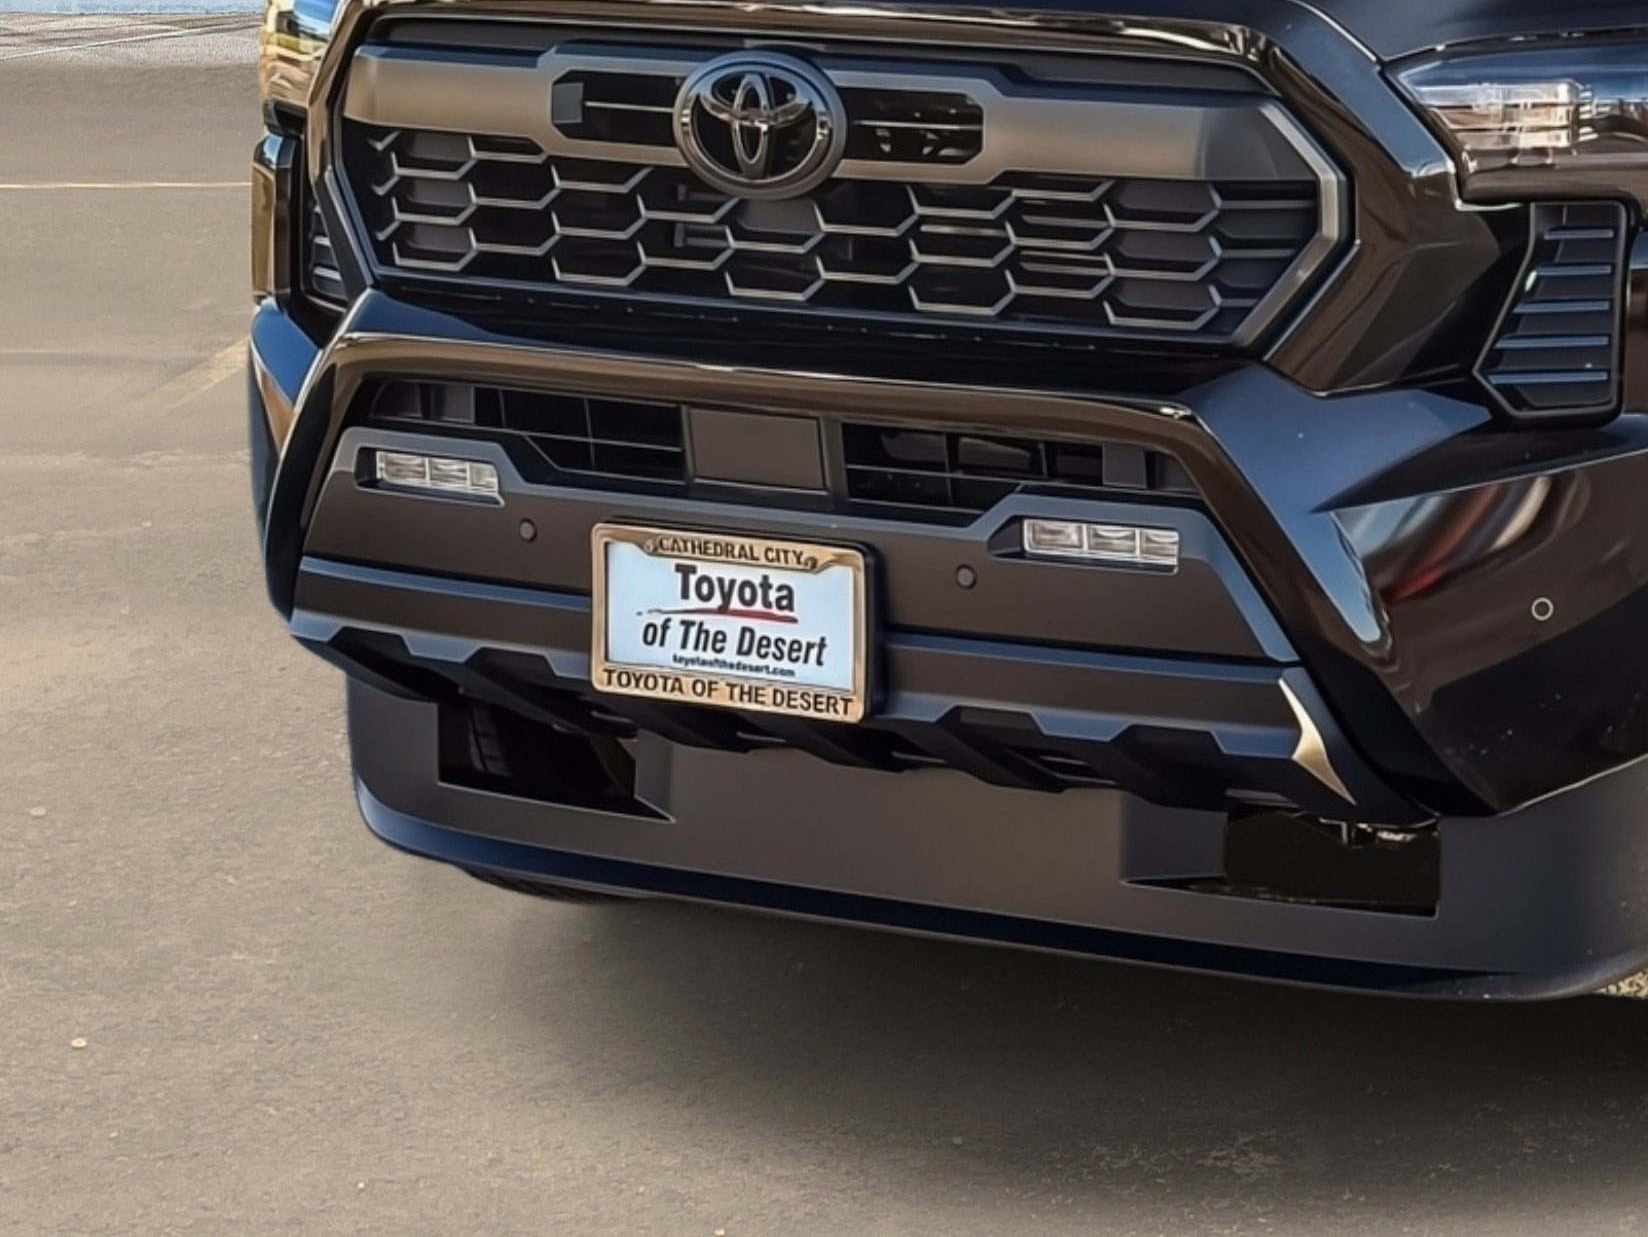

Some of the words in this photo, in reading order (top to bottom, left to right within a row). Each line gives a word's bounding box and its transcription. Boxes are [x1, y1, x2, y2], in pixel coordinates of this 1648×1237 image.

[659, 537, 760, 561] CATHEDRAL
[764, 547, 804, 566] CITY
[675, 564, 795, 612] Toyota
[643, 618, 672, 648] of
[679, 620, 727, 654] The
[736, 626, 828, 667] Desert
[603, 669, 685, 695] TOYOTA
[692, 679, 721, 698] OF
[726, 683, 766, 705] THE
[772, 692, 854, 716] DESERT
